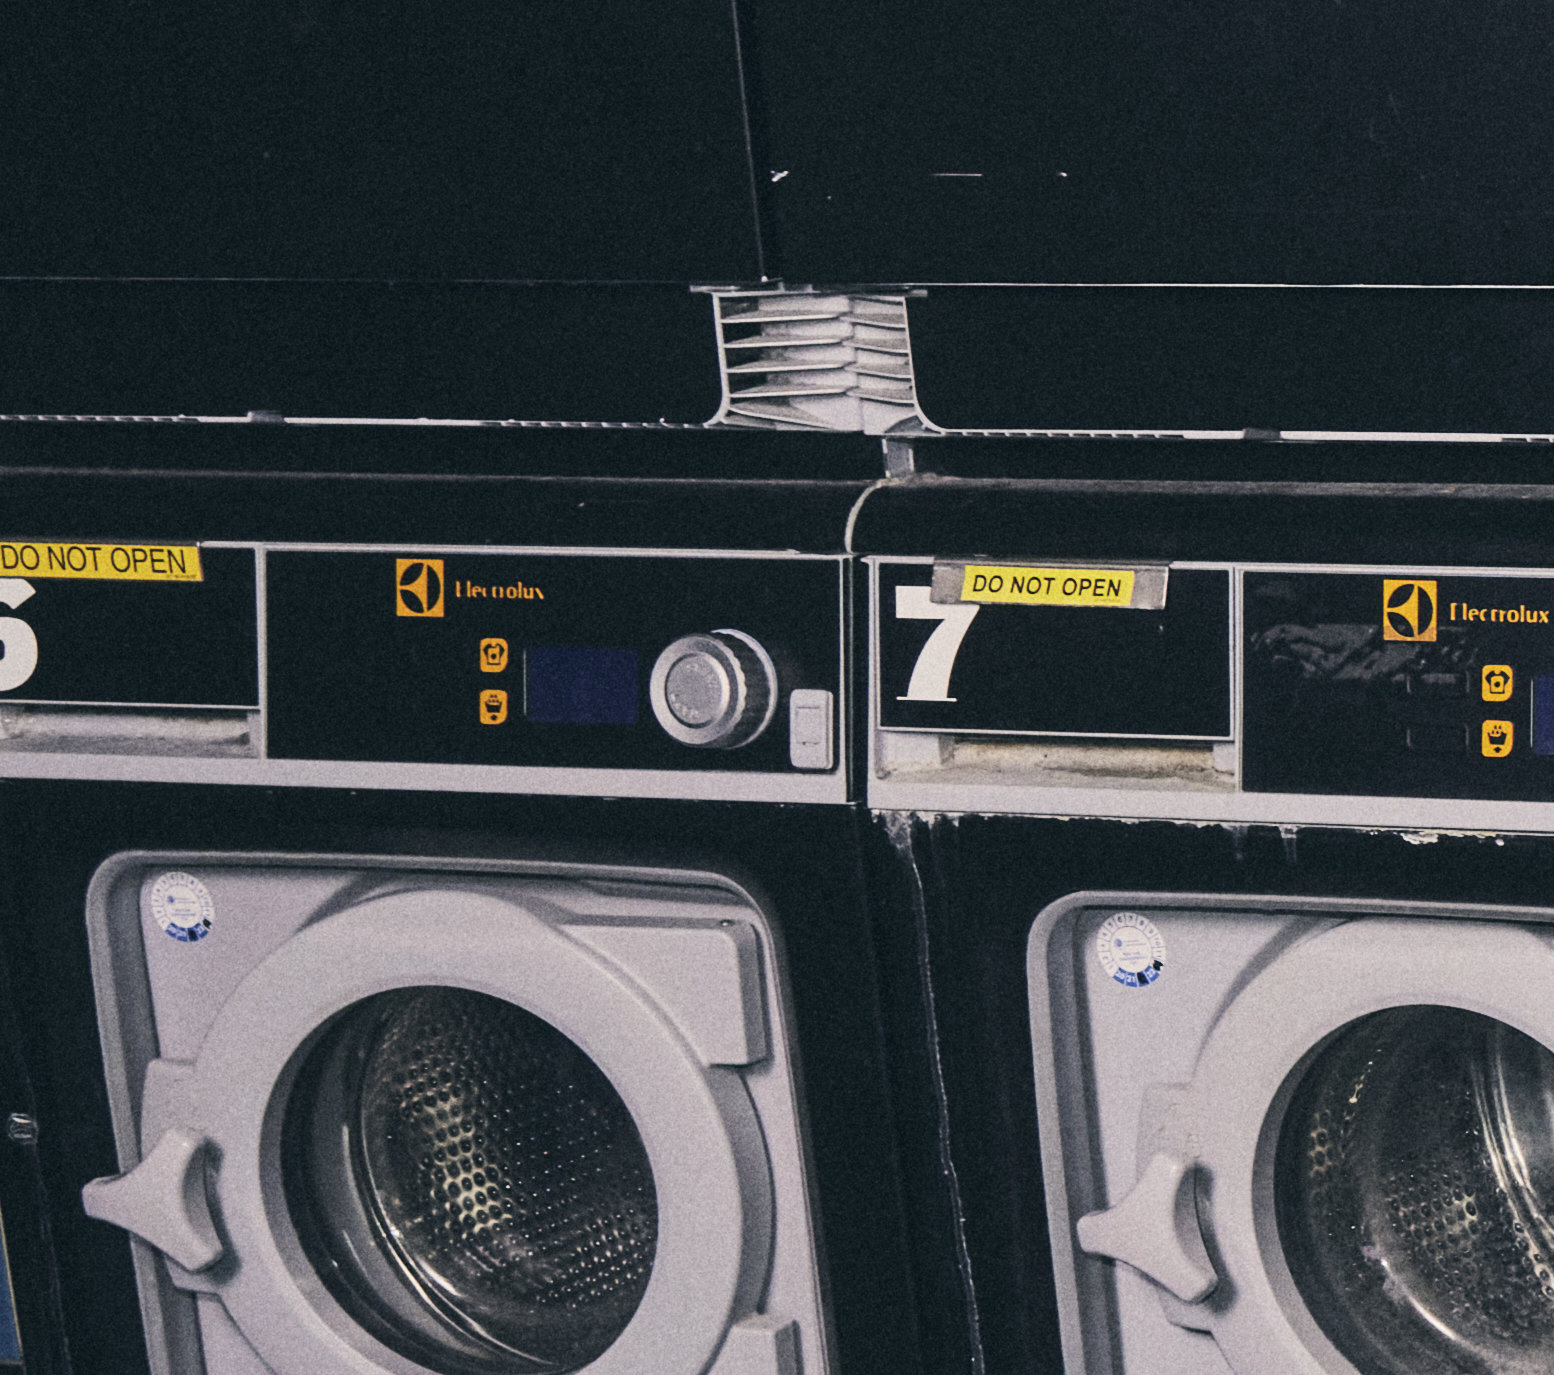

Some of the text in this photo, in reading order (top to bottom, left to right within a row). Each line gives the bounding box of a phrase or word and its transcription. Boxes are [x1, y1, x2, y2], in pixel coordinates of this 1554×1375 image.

[1, 544, 186, 574] DO NOT OPEN
[973, 574, 1121, 597] DO NOT OPEN
[895, 586, 981, 702] 7
